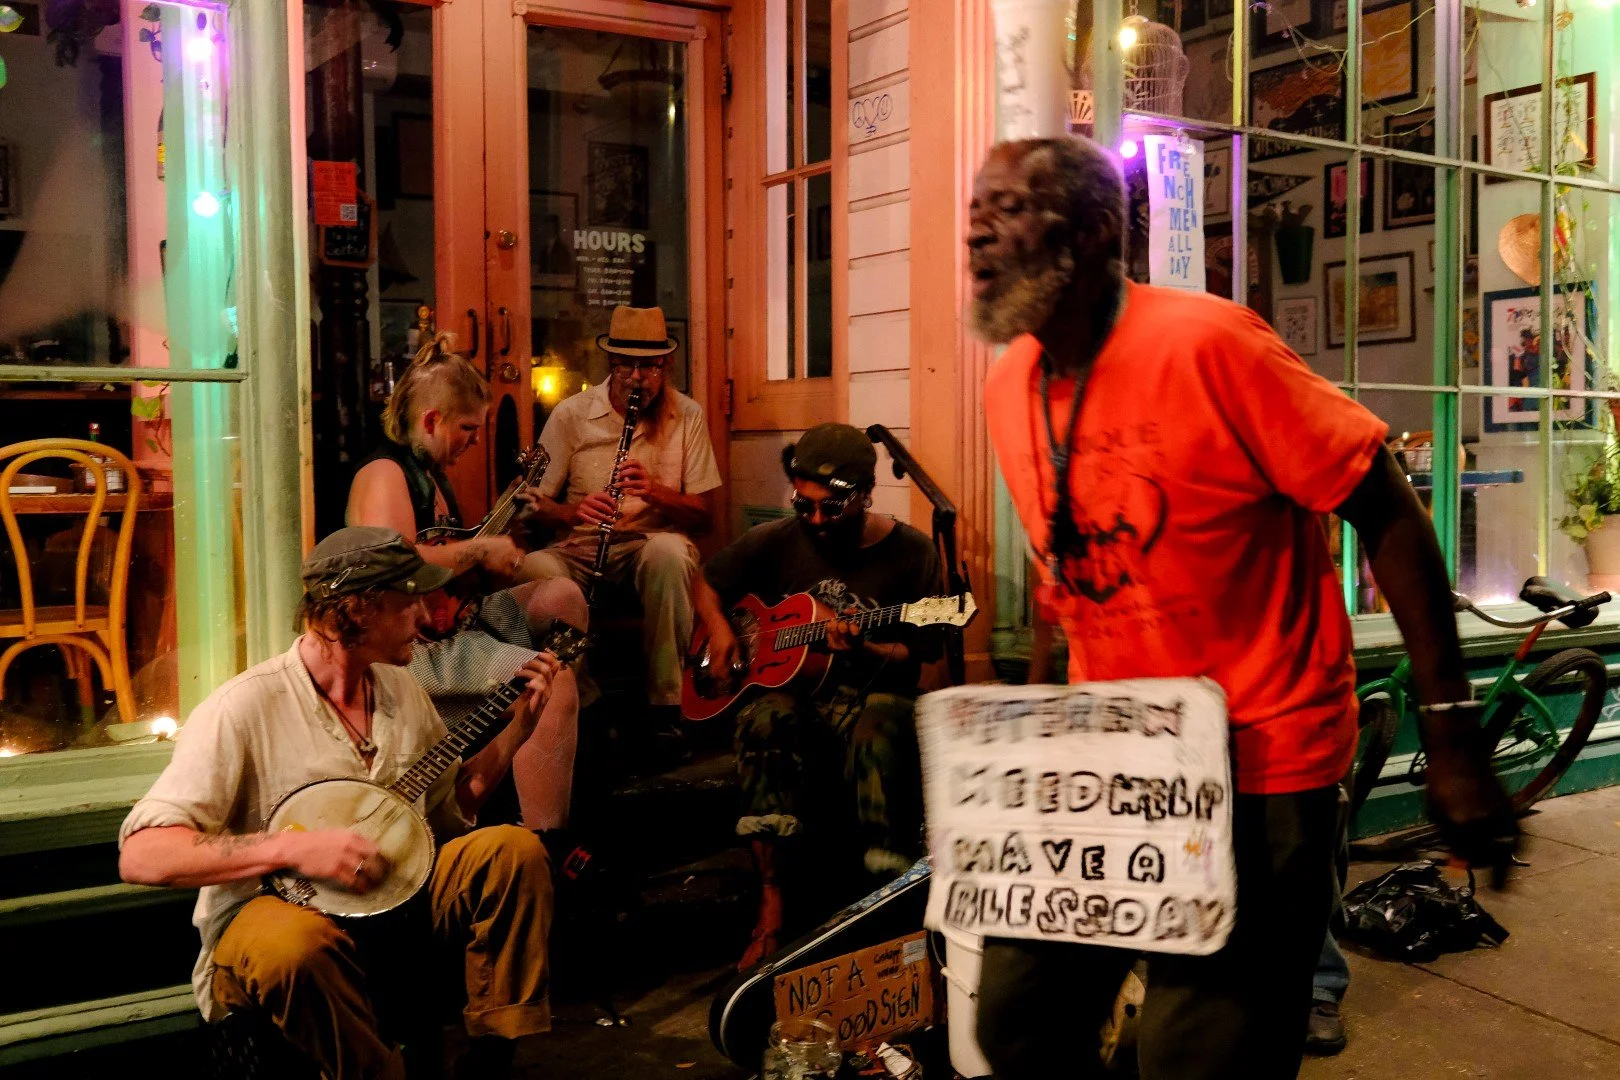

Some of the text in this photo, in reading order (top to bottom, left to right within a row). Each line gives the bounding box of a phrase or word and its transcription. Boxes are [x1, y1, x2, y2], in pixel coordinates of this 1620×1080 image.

[1164, 175, 1194, 209] NCH
[1169, 207, 1197, 231] MEN
[573, 230, 646, 253] HOURS
[1168, 234, 1192, 253] ALL
[952, 832, 1166, 883] HAVE A
[789, 959, 867, 1015] NOT A
